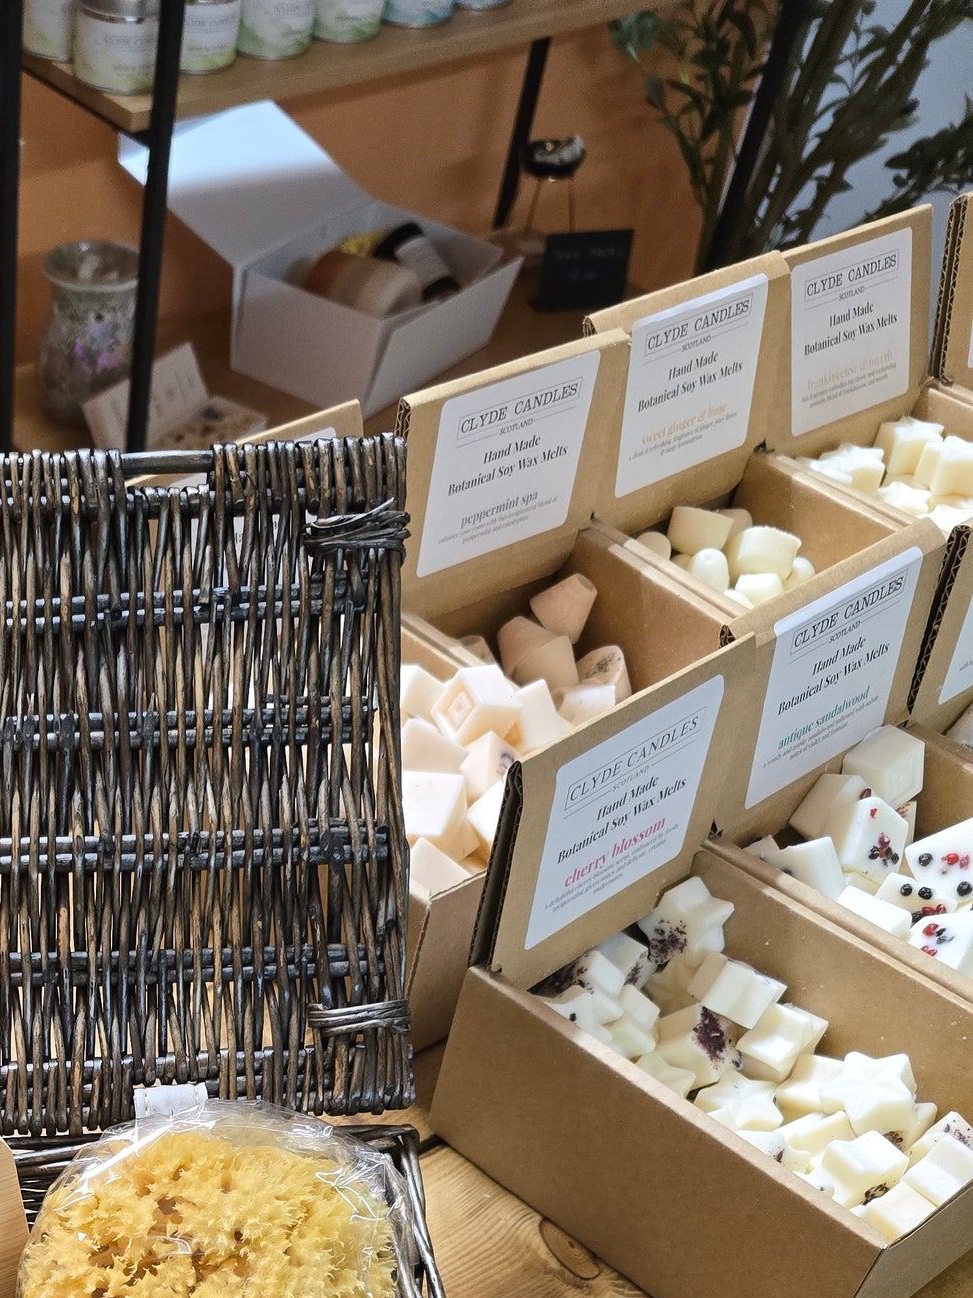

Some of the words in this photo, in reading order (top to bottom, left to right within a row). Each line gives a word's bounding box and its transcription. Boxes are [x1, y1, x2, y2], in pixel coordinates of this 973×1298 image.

[807, 273, 843, 296] CLYDE
[848, 254, 897, 282] CANDLES
[839, 286, 865, 301] SCOTLAND
[647, 322, 689, 350] CLYDE
[694, 299, 749, 332] CANDLES
[804, 331, 841, 356] Botanical
[843, 329, 857, 342] Soy
[858, 322, 875, 335] Wax
[876, 313, 897, 329] Melts
[829, 308, 851, 328] Hand
[853, 301, 874, 319] Made
[681, 334, 711, 352] SCOTLAND
[637, 384, 679, 412] Botanical
[681, 381, 695, 395] Soy
[699, 373, 717, 386] Wax
[719, 361, 743, 379] Melts
[668, 359, 693, 380] Hand
[694, 351, 719, 370] Made
[461, 406, 508, 434] CLYDE
[514, 382, 579, 415] CANDLES
[499, 418, 533, 436] SCOTLAND
[641, 426, 665, 446] sweet
[667, 415, 695, 438] ginger
[707, 400, 727, 418] lime
[448, 468, 495, 496] Botanical
[497, 464, 515, 478] Soy
[518, 456, 539, 470] Wax
[541, 445, 567, 463] Melts
[483, 443, 511, 464] Hand
[513, 434, 541, 454] Made
[460, 496, 519, 529] peppermint
[520, 491, 538, 505] spa
[794, 612, 839, 648] CLYDE
[844, 576, 904, 619] CANDLES
[829, 620, 861, 644] SCOTLAND
[812, 649, 839, 675] Hand
[839, 636, 866, 660] Made
[777, 678, 823, 715] Botanical
[823, 671, 841, 688] Soy
[844, 658, 863, 676] Wax
[863, 643, 890, 665] Melts
[777, 722, 813, 750] antique
[814, 685, 870, 728] sandalwood
[570, 760, 623, 801] CLYDE
[627, 716, 699, 768] CANDLES
[611, 765, 649, 792] SCOTLAND
[597, 792, 627, 821] Hand
[631, 776, 659, 799] Made
[557, 821, 609, 864] Botanical
[610, 813, 628, 831] Soy
[633, 797, 655, 816] Wax
[657, 778, 687, 803] Melts
[565, 854, 606, 888] cherry
[611, 818, 666, 858] blossom
